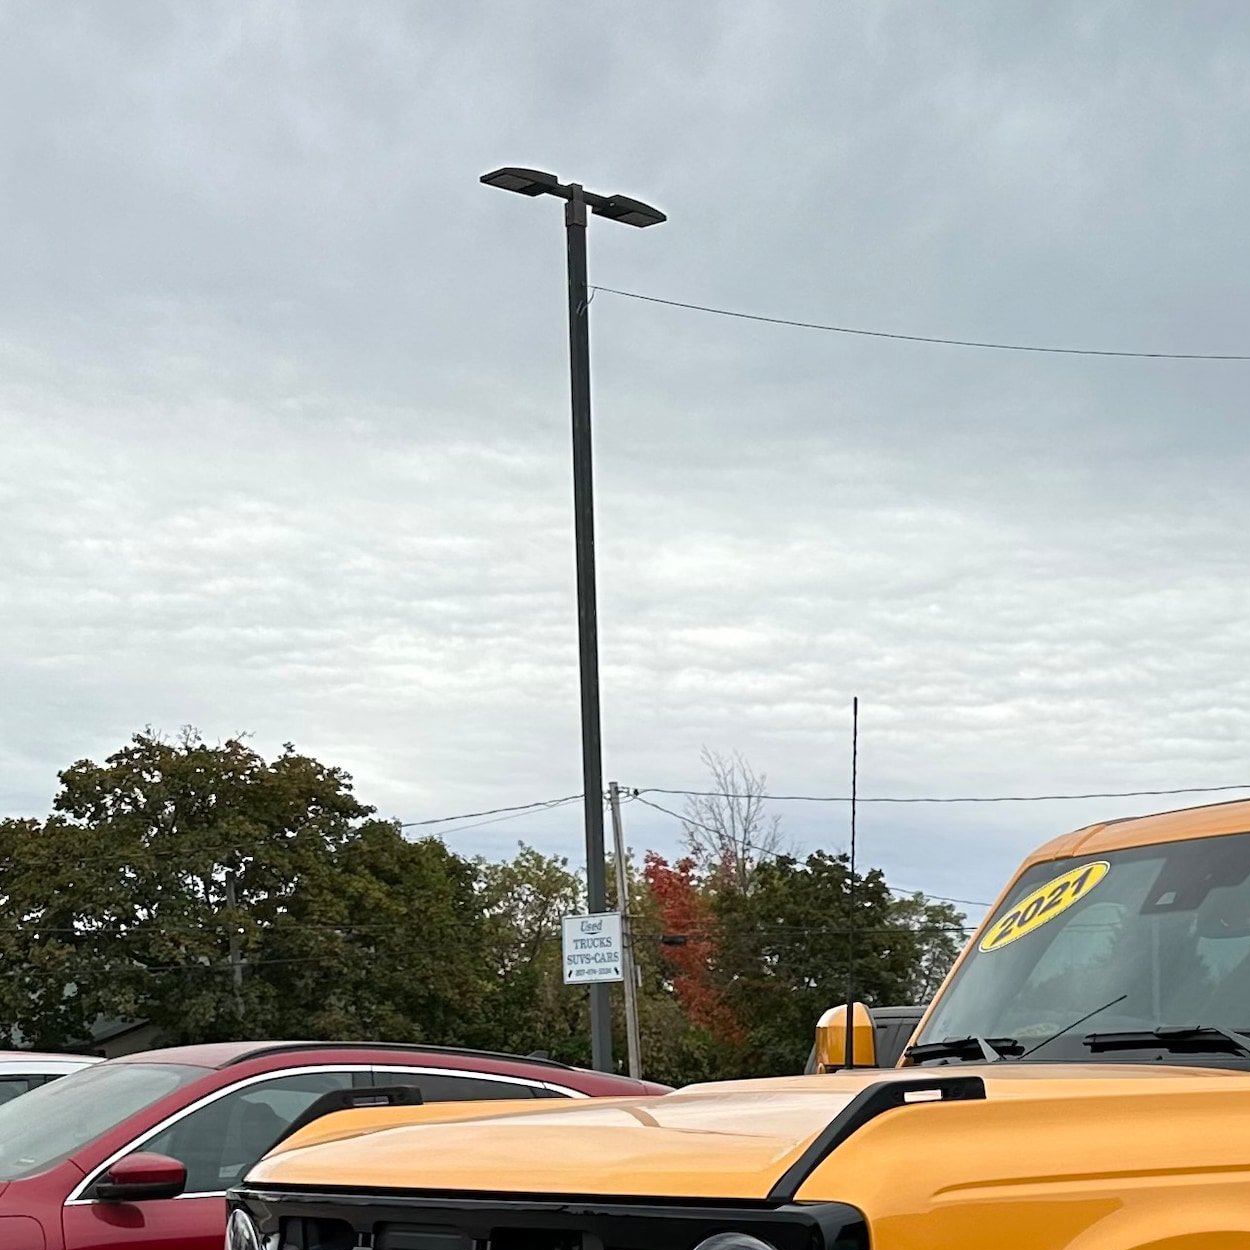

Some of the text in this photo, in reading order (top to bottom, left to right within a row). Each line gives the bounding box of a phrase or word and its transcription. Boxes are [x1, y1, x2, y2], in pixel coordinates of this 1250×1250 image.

[991, 867, 1094, 946] 2021
[580, 919, 603, 932] Used
[573, 937, 612, 950] TRUCKS
